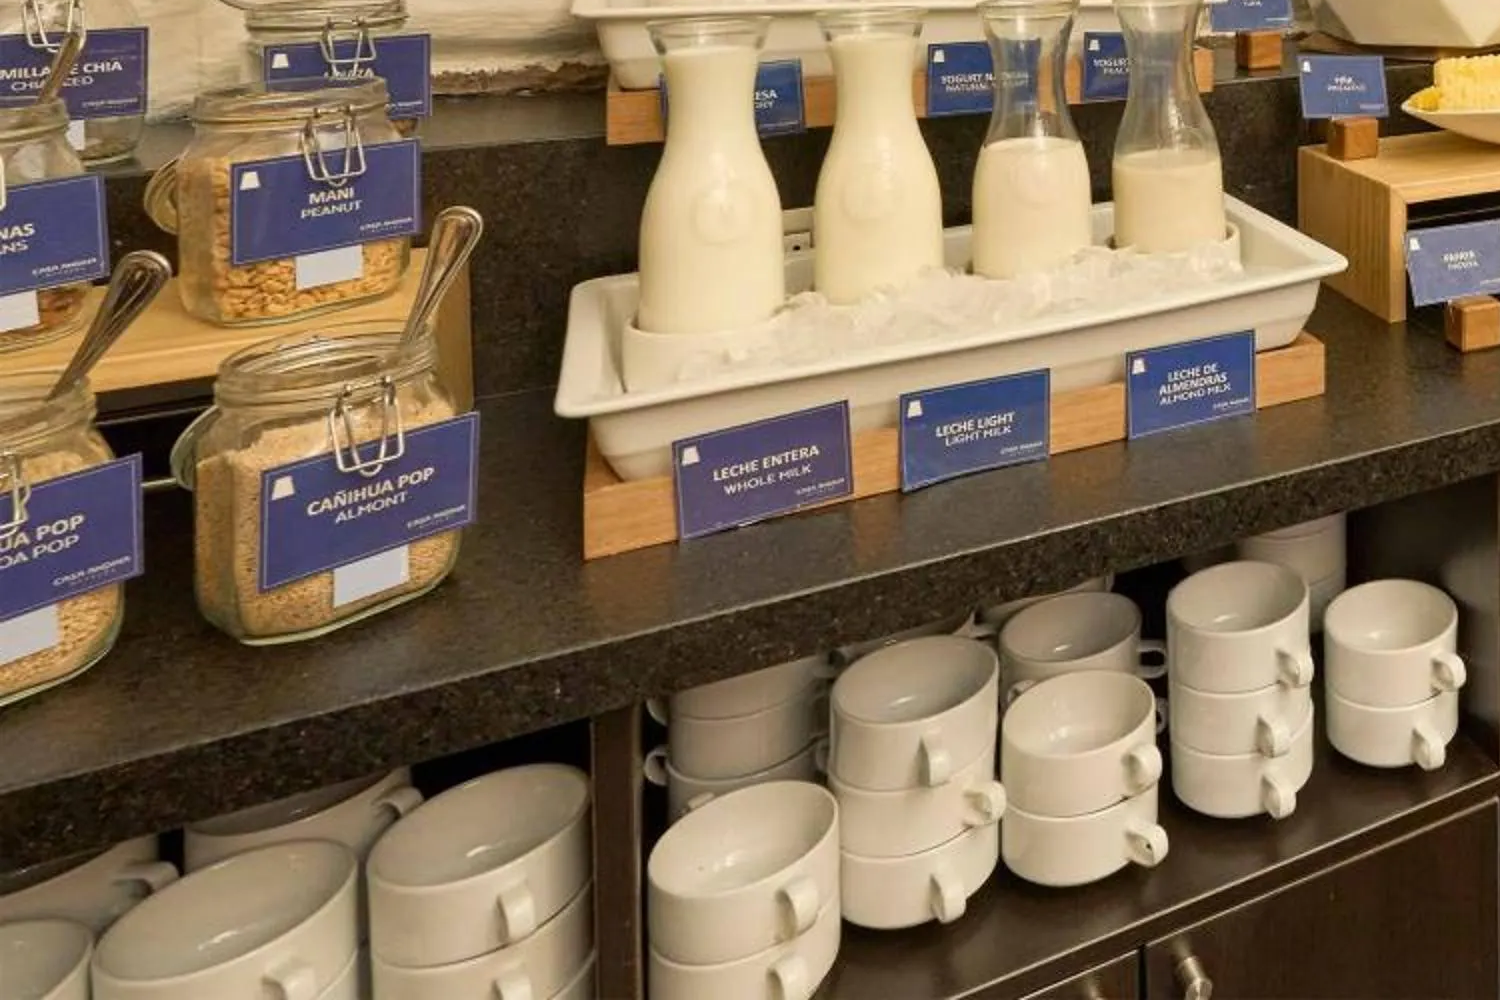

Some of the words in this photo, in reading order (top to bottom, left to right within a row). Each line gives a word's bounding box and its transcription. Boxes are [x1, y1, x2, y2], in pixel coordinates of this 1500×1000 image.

[83, 61, 122, 74] CHIA
[301, 200, 362, 219] PEANUT
[1159, 371, 1228, 397] ALMENDRAS
[1168, 366, 1201, 383] LECHE
[1203, 362, 1219, 375] DE
[1159, 387, 1205, 406] ALMOND
[935, 418, 976, 438] LECHE
[978, 410, 1016, 430] LIGHT
[945, 430, 980, 447] LIGHT
[712, 459, 759, 482] LECHE
[762, 444, 820, 470] ENTERA
[306, 480, 395, 517] CAÑIHUA
[397, 466, 435, 489] POP
[723, 473, 776, 496] WHOLE
[779, 463, 813, 481] MILK
[335, 491, 409, 524] ALMONT
[36, 513, 85, 541] POP
[32, 535, 80, 559] POP
